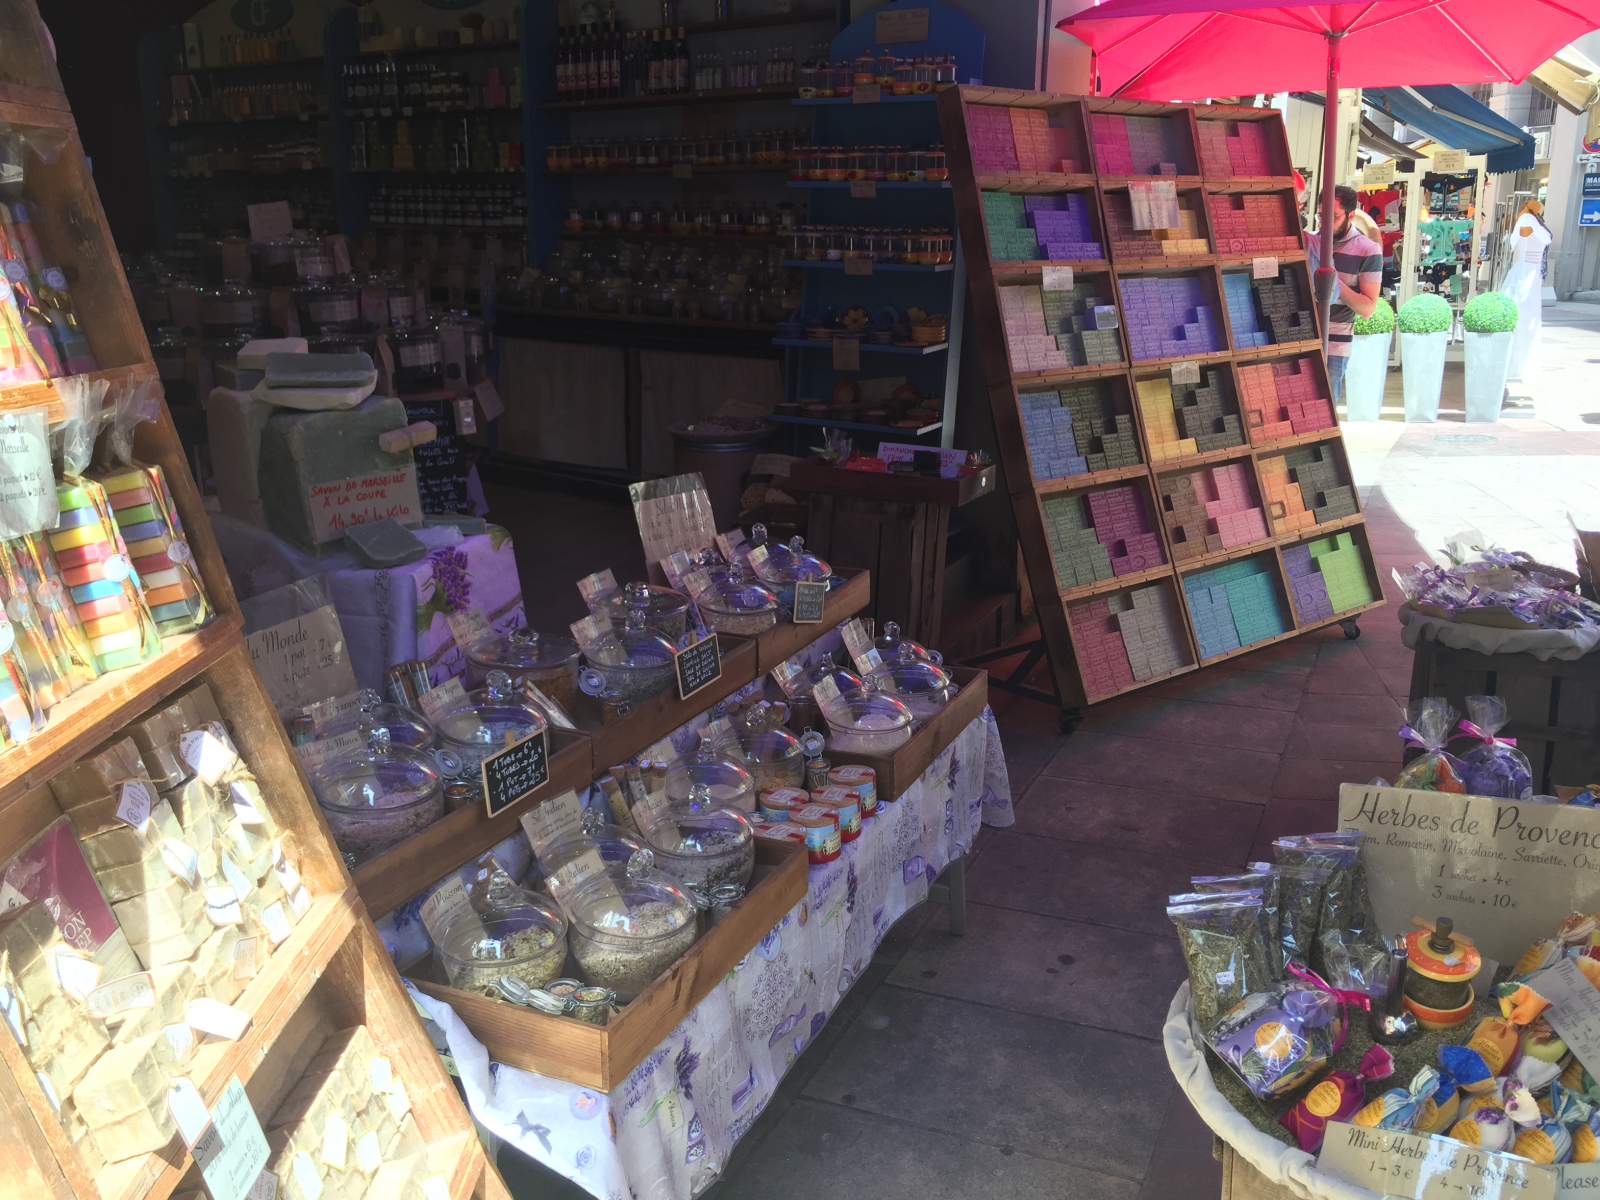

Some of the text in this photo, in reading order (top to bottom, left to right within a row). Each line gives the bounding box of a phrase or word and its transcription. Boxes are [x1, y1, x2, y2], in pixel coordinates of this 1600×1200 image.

[310, 484, 341, 498] SAVON
[346, 481, 357, 492] DE
[337, 495, 350, 506] LA
[356, 489, 387, 502] COUPE
[262, 619, 308, 655] Monde
[291, 648, 306, 667] pot
[492, 758, 498, 770] 1
[499, 754, 516, 767] TUBE
[495, 770, 501, 780] 4
[502, 763, 520, 777] TUBES
[506, 775, 518, 787] POT
[500, 792, 506, 802] 4
[508, 786, 522, 798] POTS
[1343, 792, 1441, 831] Herbes
[1450, 800, 1479, 835] de
[1513, 846, 1567, 868] Sarriette,
[1438, 864, 1446, 878] 1
[1449, 869, 1477, 883] sachet
[435, 882, 463, 905] Poisson
[1431, 885, 1442, 899] 3
[1445, 890, 1476, 905] sachets
[1347, 1127, 1379, 1150] Mini
[1382, 1135, 1437, 1163] Herbes
[1369, 1161, 1375, 1172] 1
[1391, 1165, 1401, 1177] 3
[1440, 1177, 1448, 1188] 4
